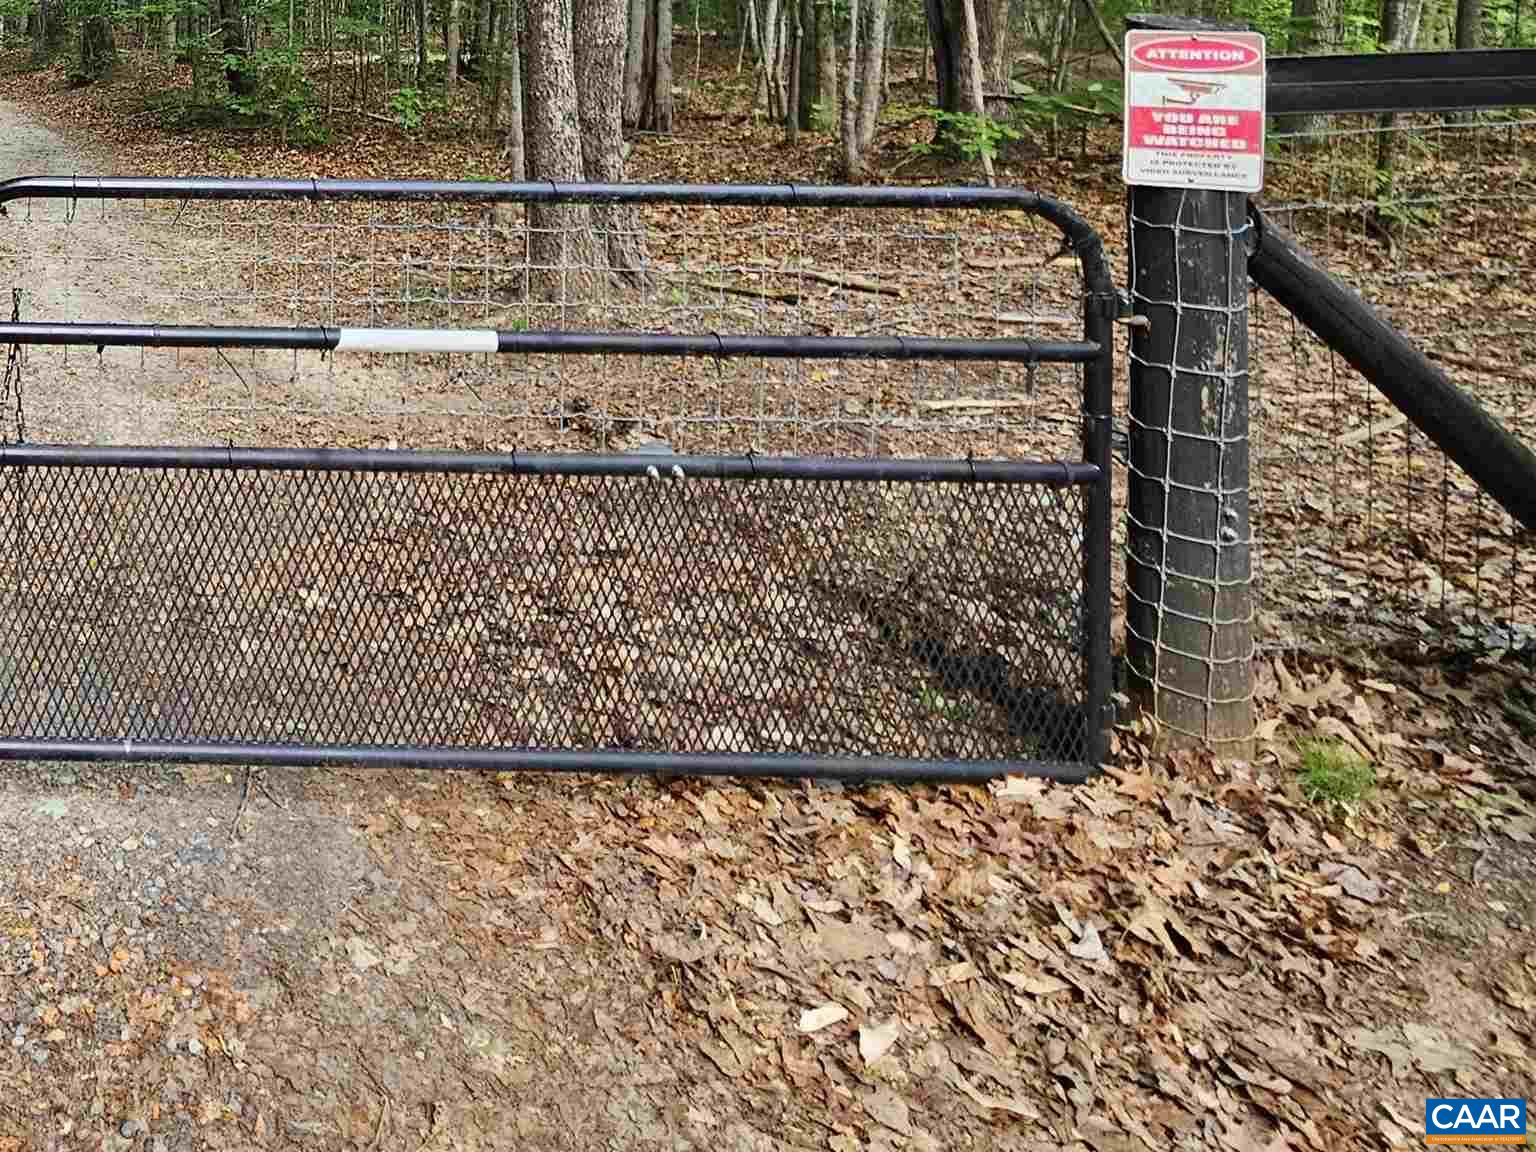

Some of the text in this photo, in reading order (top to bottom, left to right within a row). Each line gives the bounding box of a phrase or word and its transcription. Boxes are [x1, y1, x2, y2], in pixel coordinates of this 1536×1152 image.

[1146, 49, 1245, 62] ATTENTION
[1152, 111, 1240, 126] YOU ARE
[1163, 124, 1227, 137] BEING
[1143, 135, 1248, 150] WATCHED
